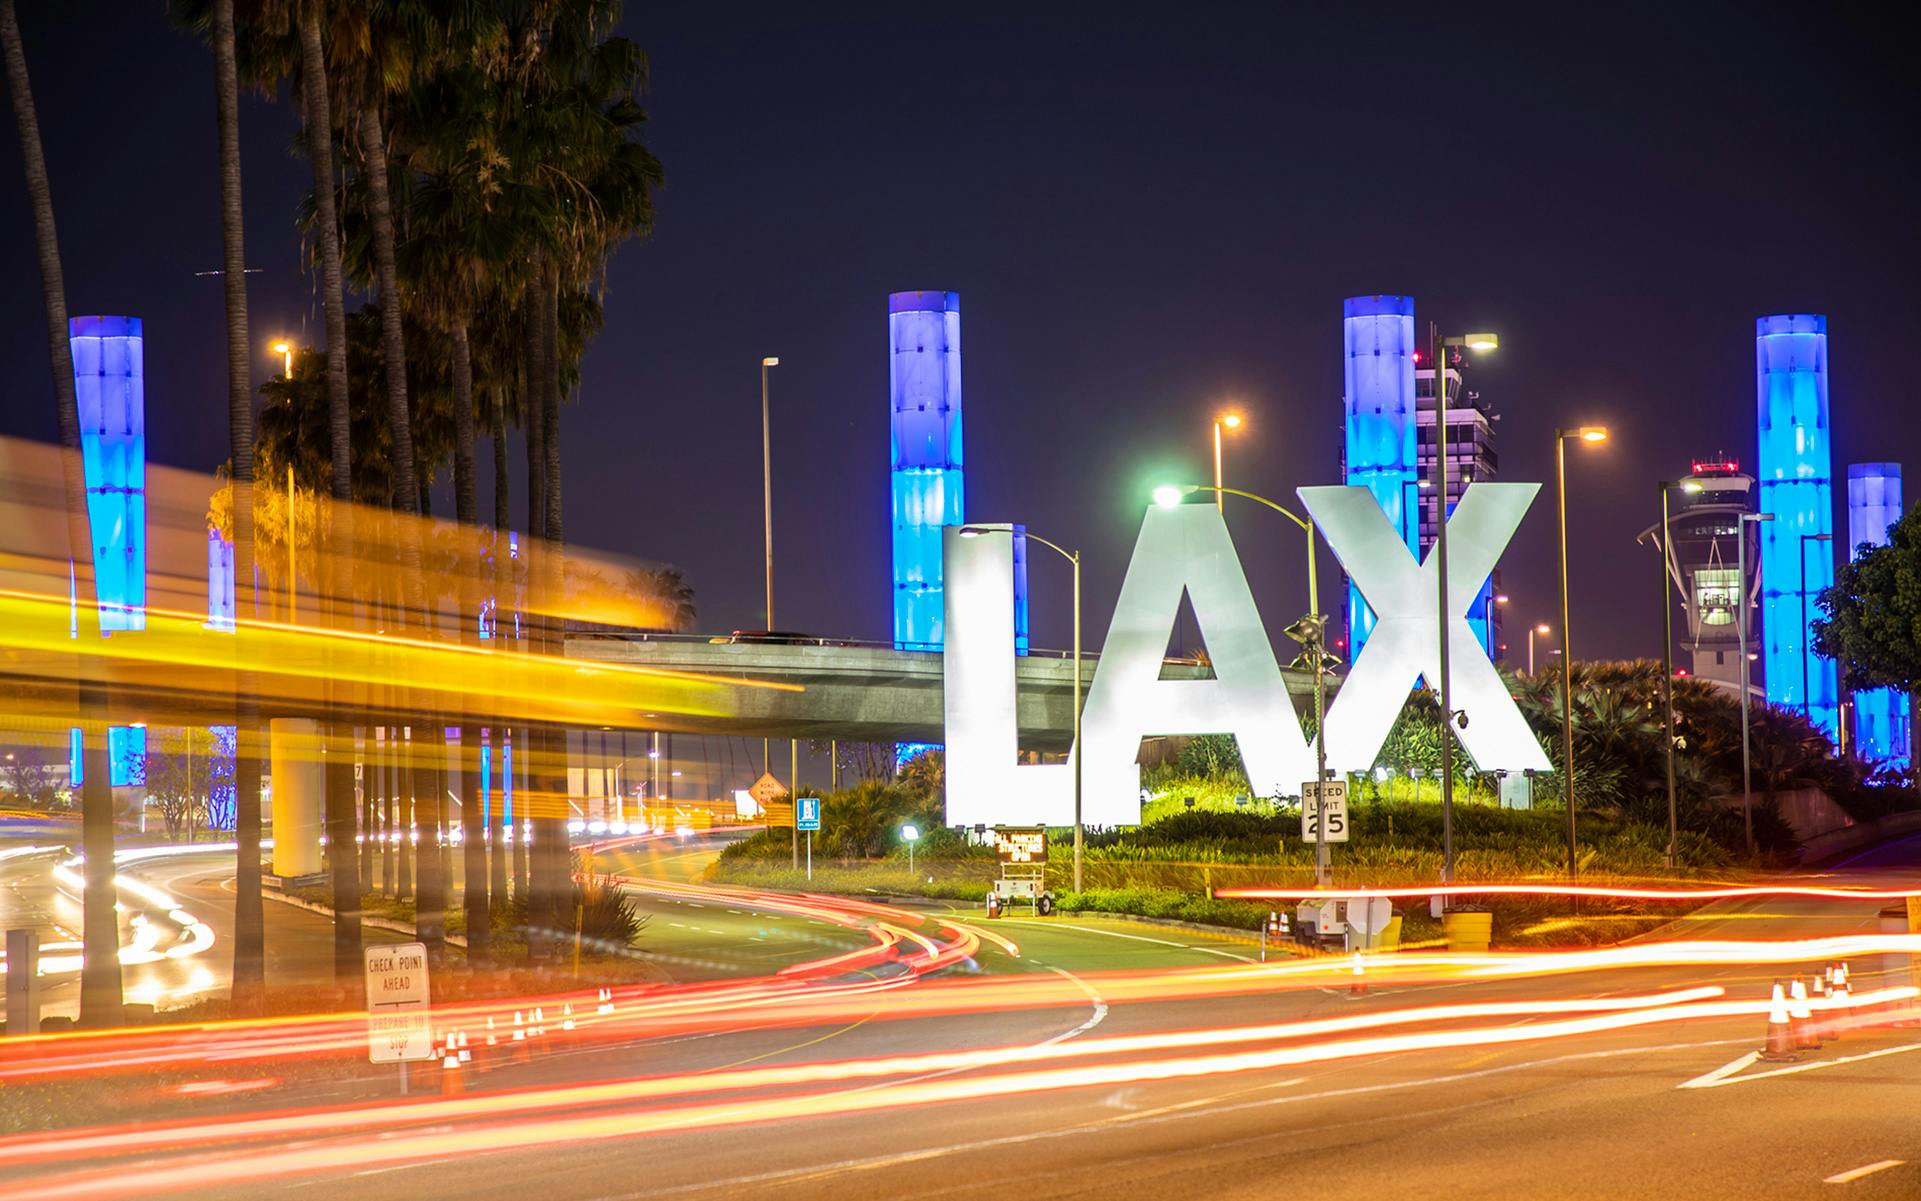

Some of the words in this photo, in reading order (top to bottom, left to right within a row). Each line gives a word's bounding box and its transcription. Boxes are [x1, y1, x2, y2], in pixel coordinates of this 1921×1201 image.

[943, 482, 1553, 827] LAX
[1310, 801, 1339, 811] LMIT
[1308, 814, 1344, 834] 25
[369, 958, 394, 973] CHECK
[400, 956, 423, 971] POINT
[383, 976, 410, 991] AHEAD
[373, 1016, 408, 1030] PREPARE
[390, 1034, 409, 1050] STOP
